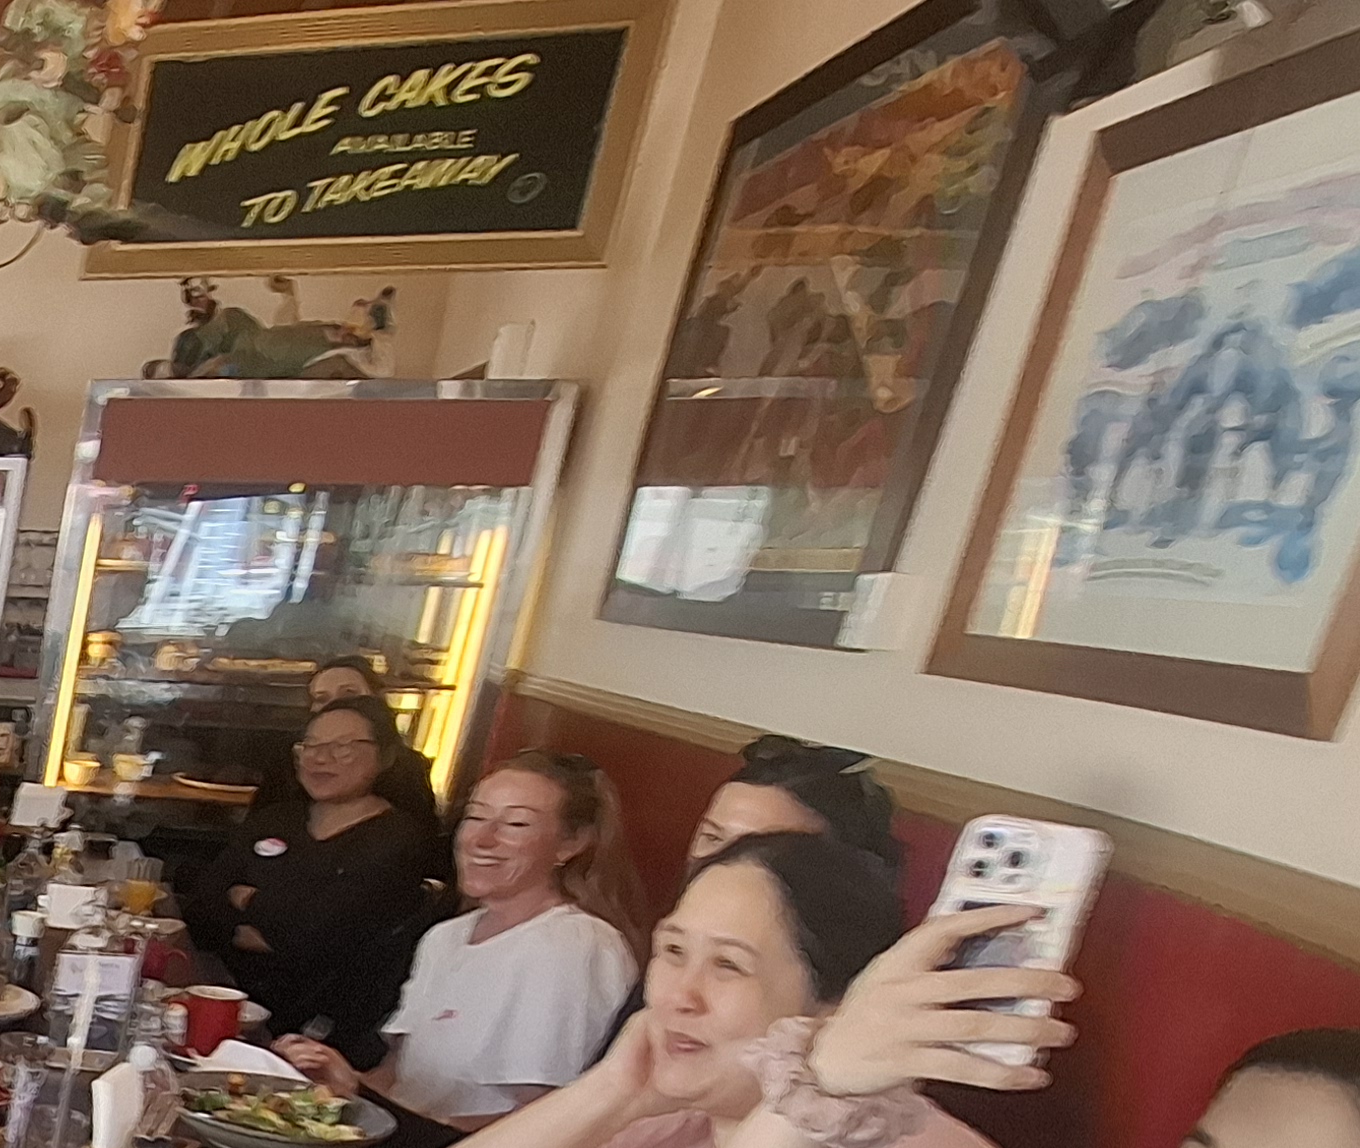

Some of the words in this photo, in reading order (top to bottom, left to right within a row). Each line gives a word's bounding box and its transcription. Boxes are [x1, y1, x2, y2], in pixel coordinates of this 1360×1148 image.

[165, 86, 350, 183] WHOLE
[358, 53, 541, 118] CAKES
[330, 129, 478, 156] AVAILABLE
[240, 189, 299, 228] TO
[301, 153, 520, 213] TAKEAWAY
